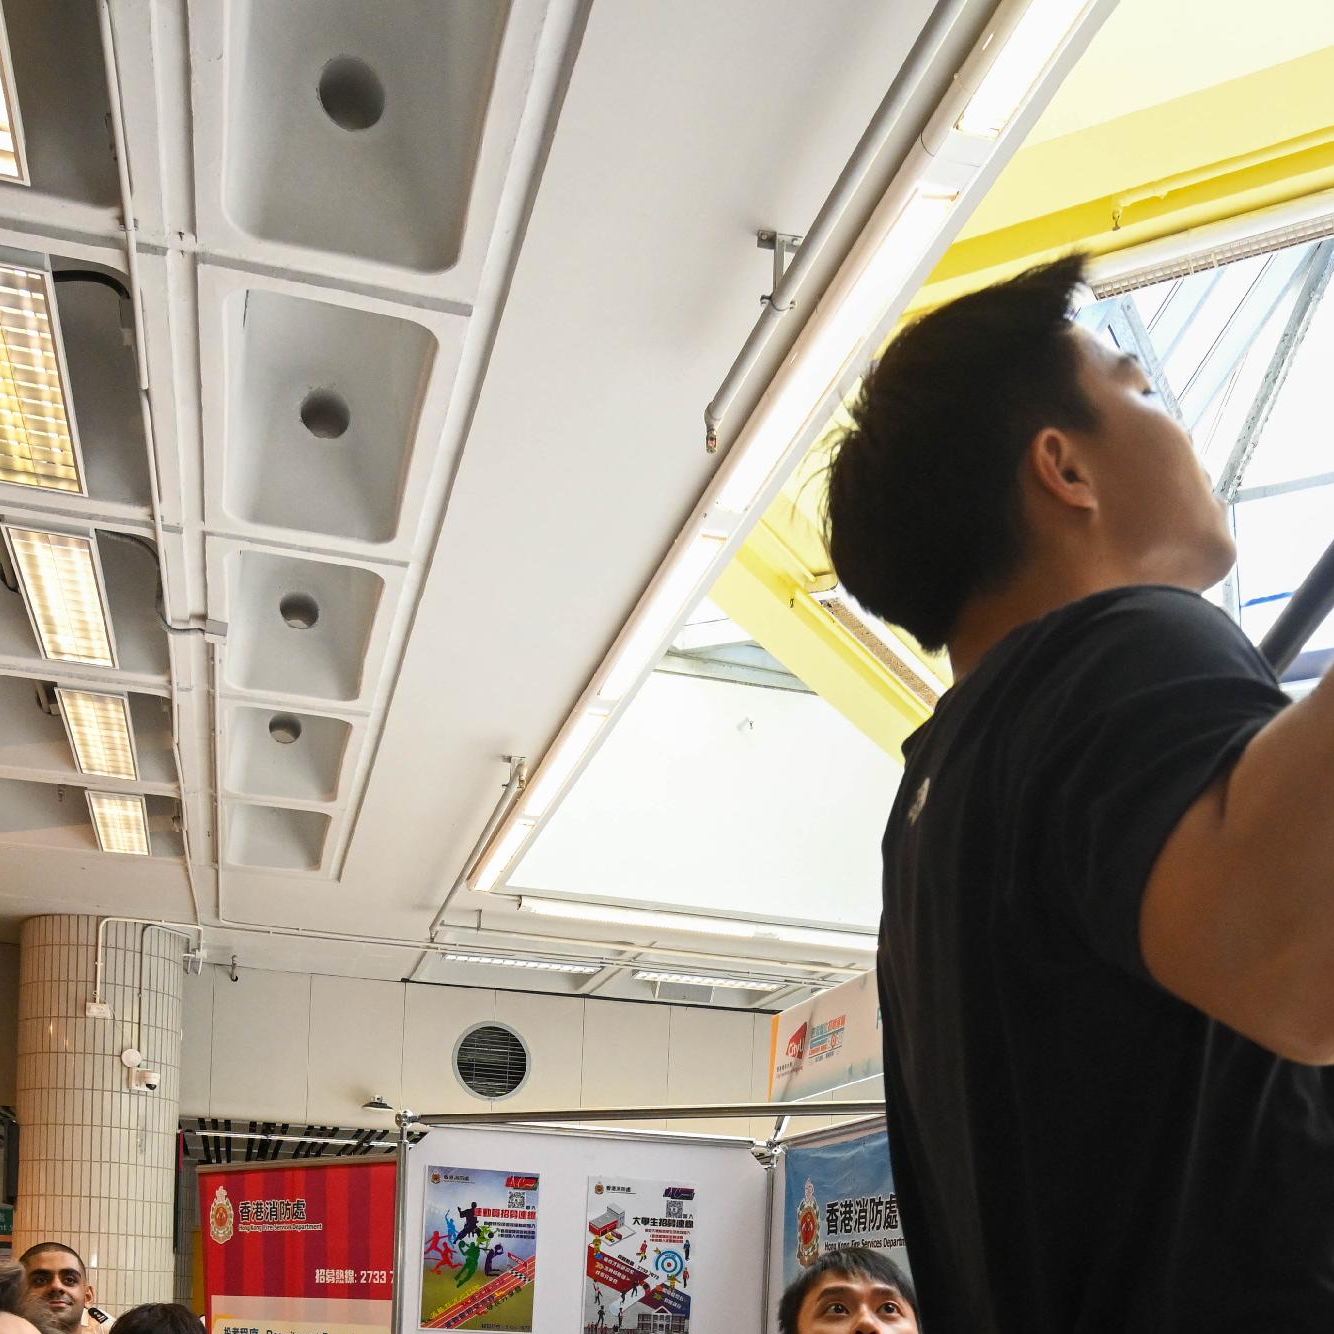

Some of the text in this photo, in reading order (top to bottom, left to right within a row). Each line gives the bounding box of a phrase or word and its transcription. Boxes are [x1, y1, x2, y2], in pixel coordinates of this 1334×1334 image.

[239, 1200, 306, 1222] 香港消防處
[825, 1193, 899, 1236] 香港消防處
[861, 1238, 882, 1248] Services
[360, 1270, 386, 1283] 2733
